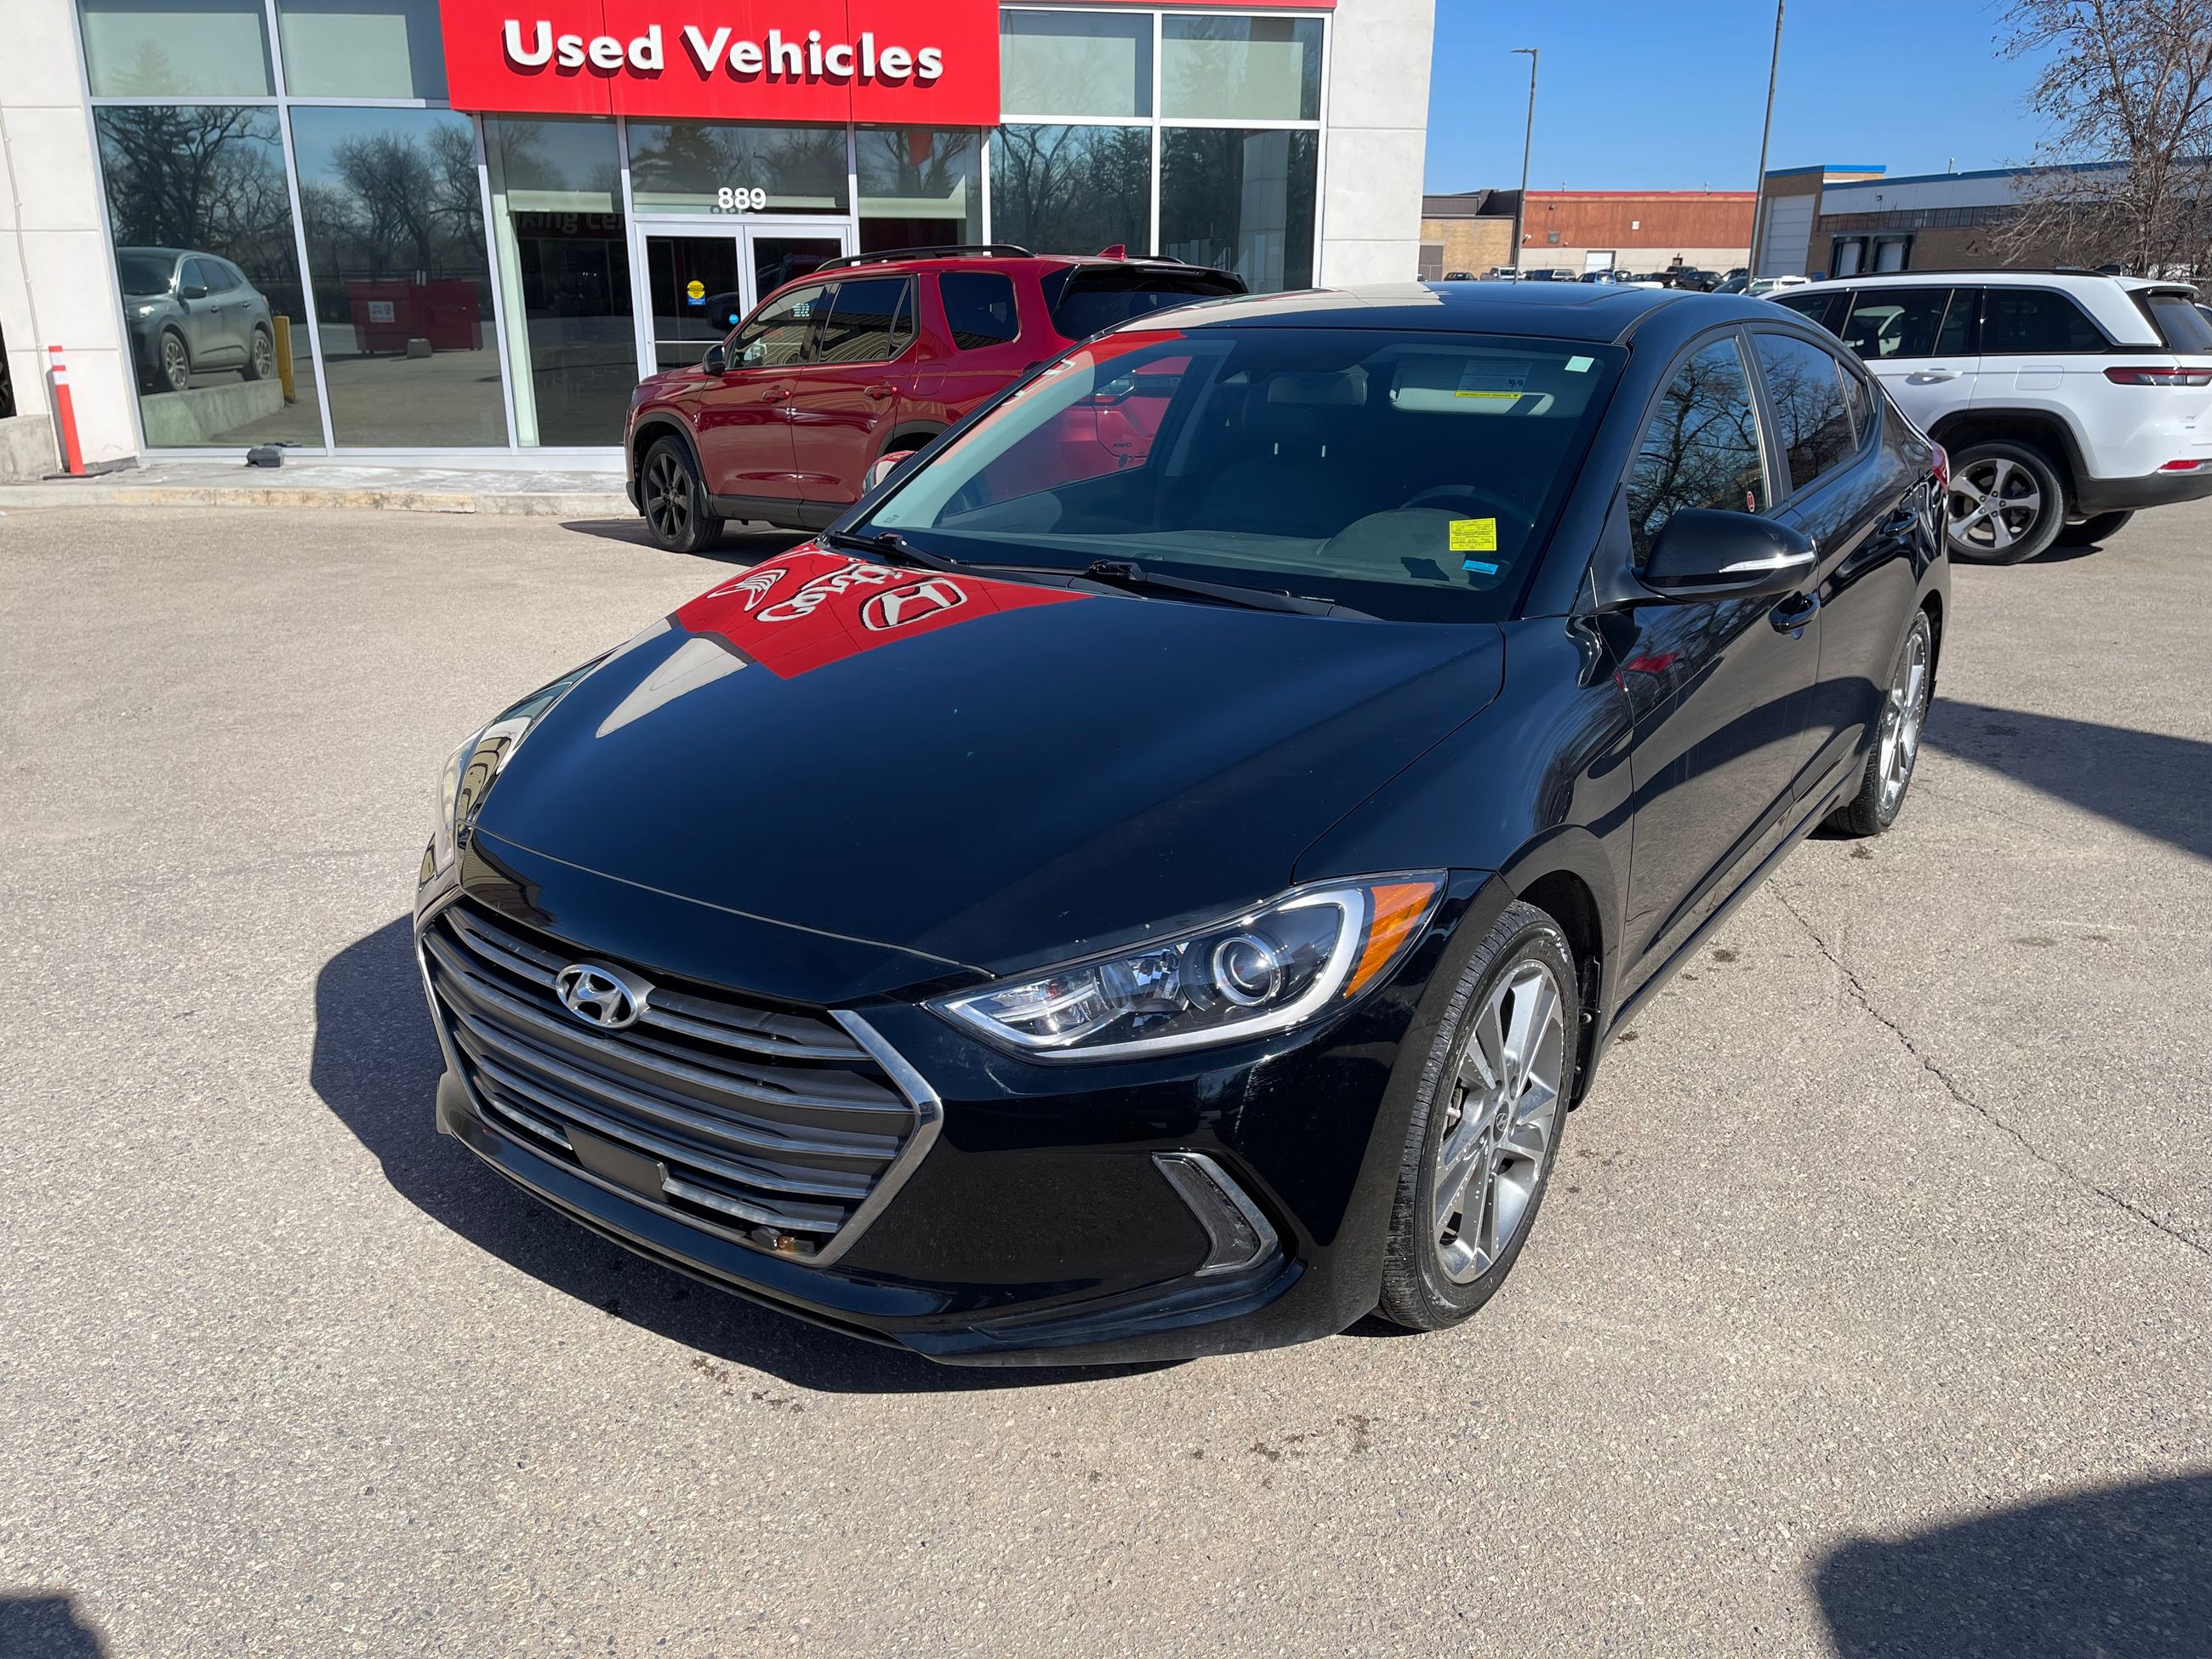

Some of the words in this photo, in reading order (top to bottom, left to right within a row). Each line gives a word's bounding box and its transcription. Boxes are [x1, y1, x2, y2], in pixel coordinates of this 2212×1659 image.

[504, 19, 664, 71] Used
[683, 25, 944, 80] Vehicles
[717, 186, 767, 210] 889
